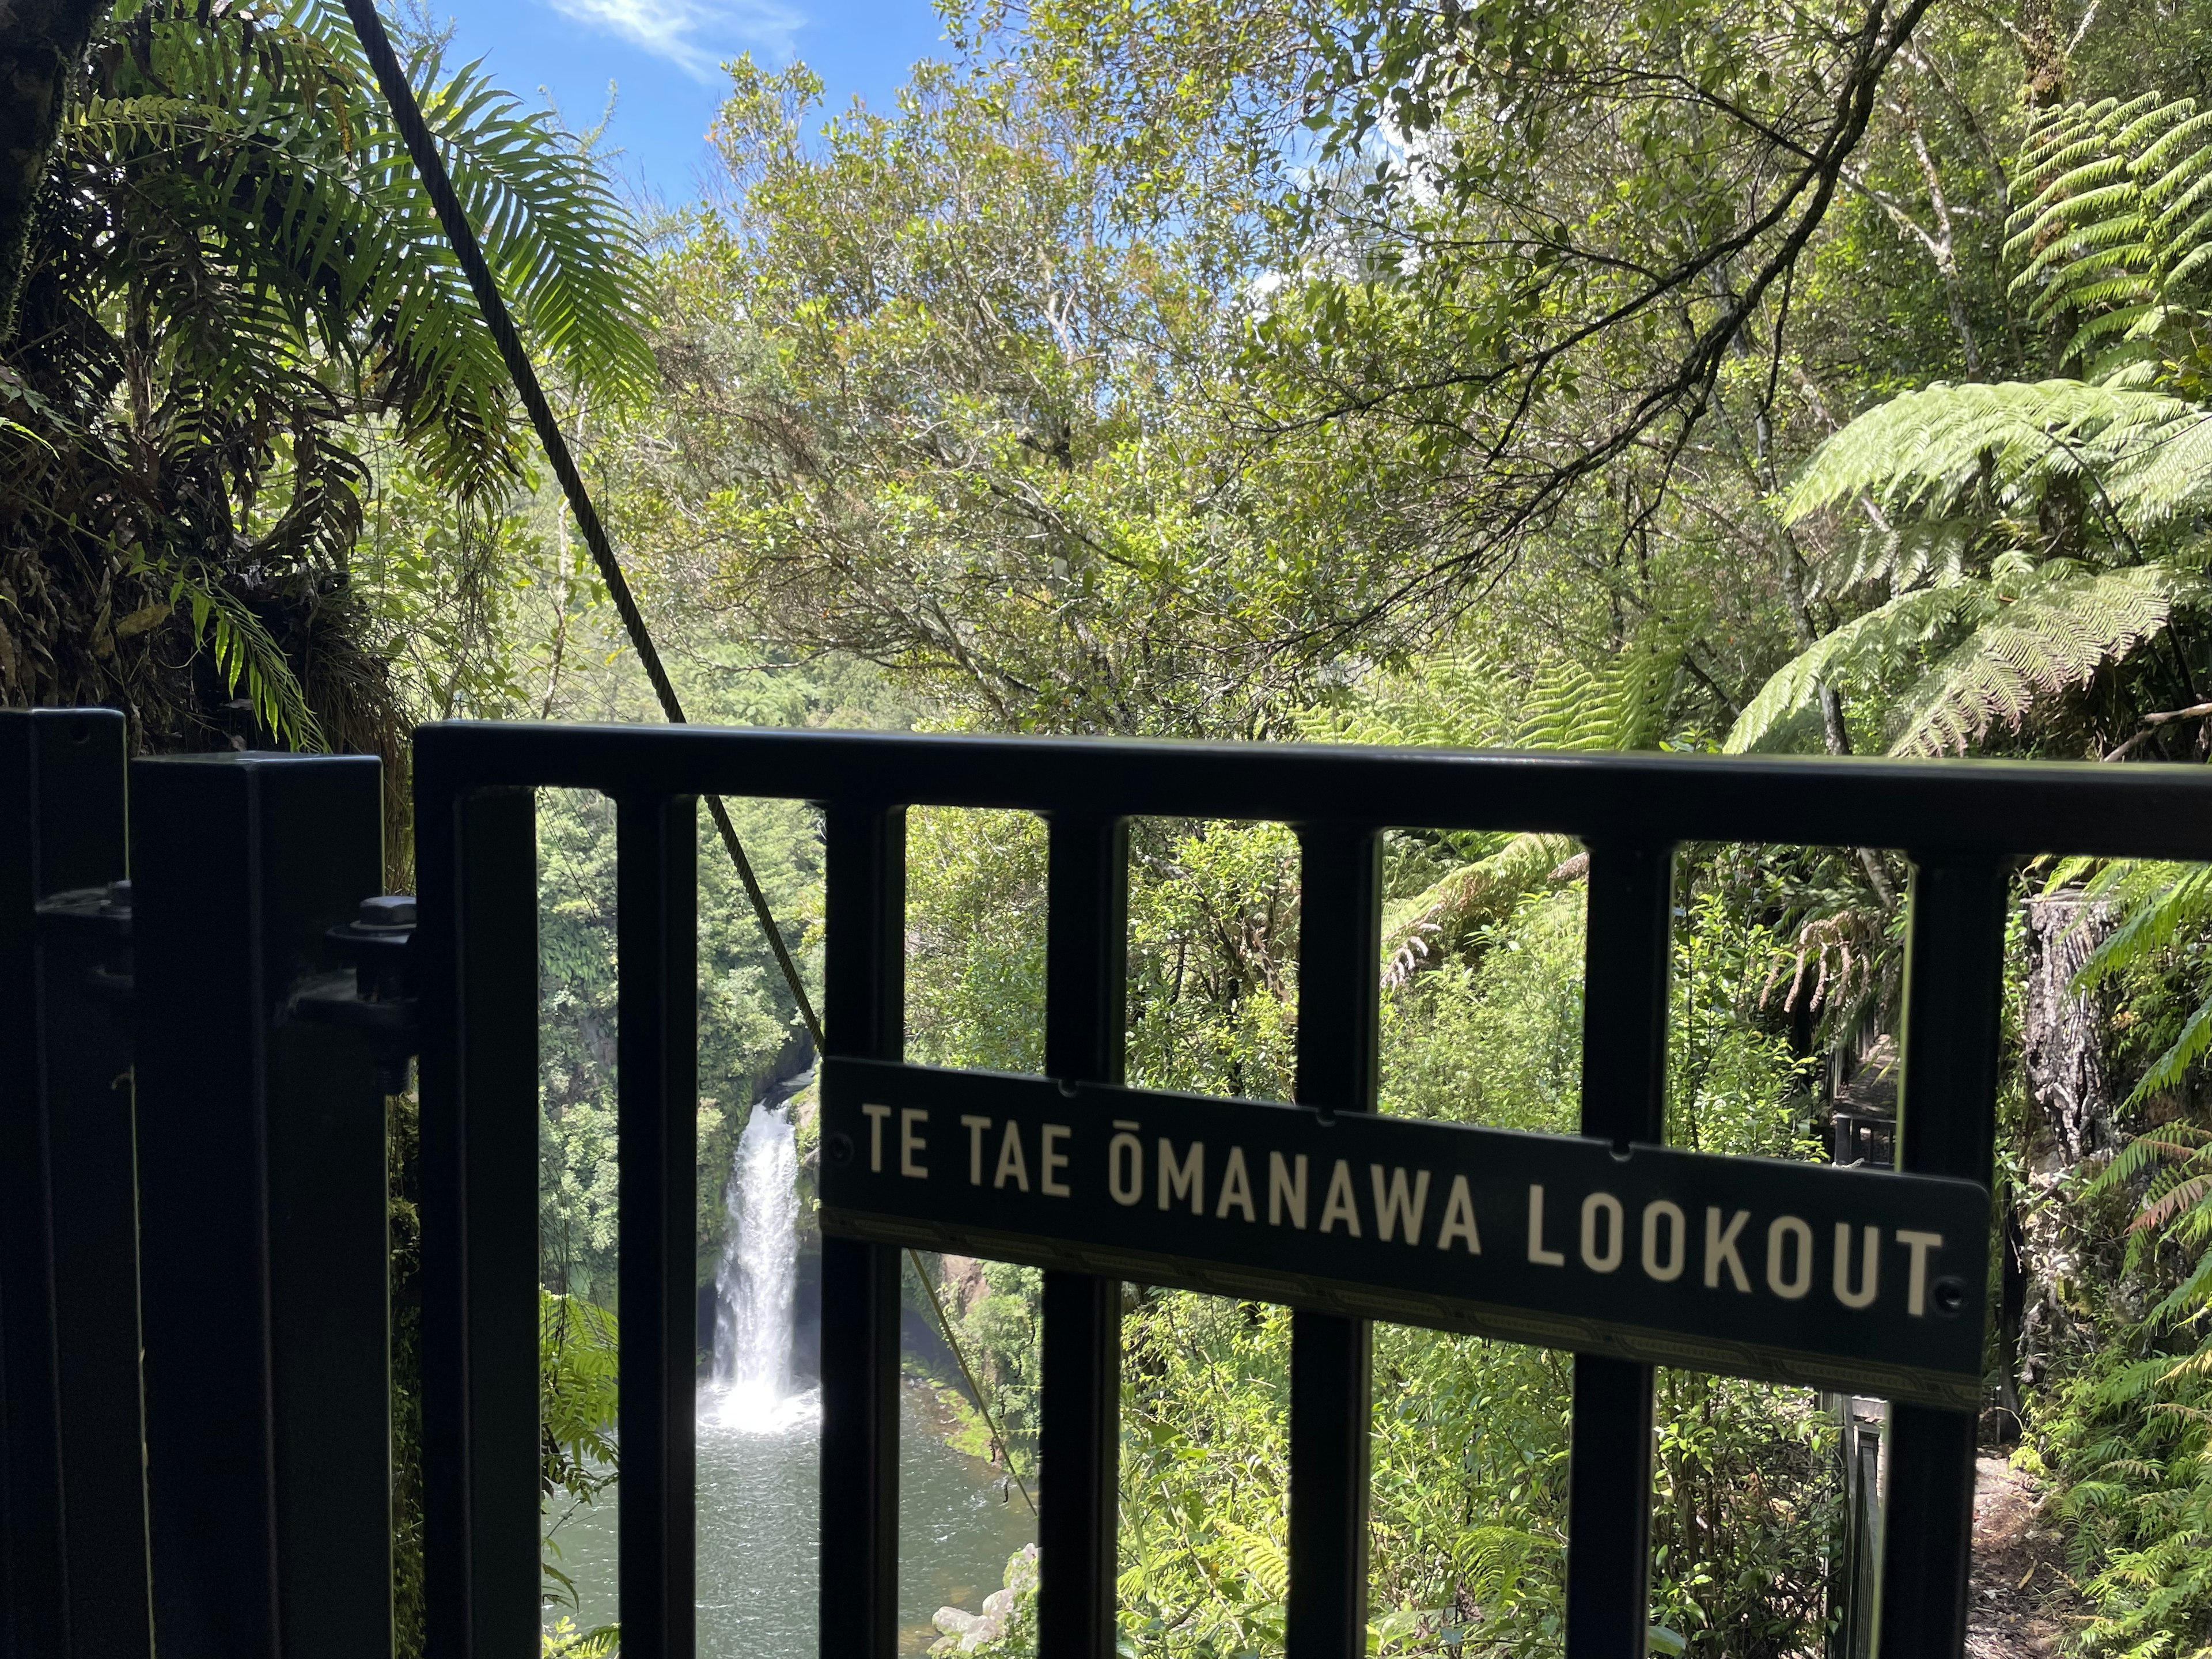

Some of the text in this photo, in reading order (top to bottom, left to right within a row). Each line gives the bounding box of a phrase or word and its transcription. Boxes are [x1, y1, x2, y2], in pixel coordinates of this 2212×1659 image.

[862, 1103, 1944, 1317] TE TAE ŌMANAWA LOOKOUT
